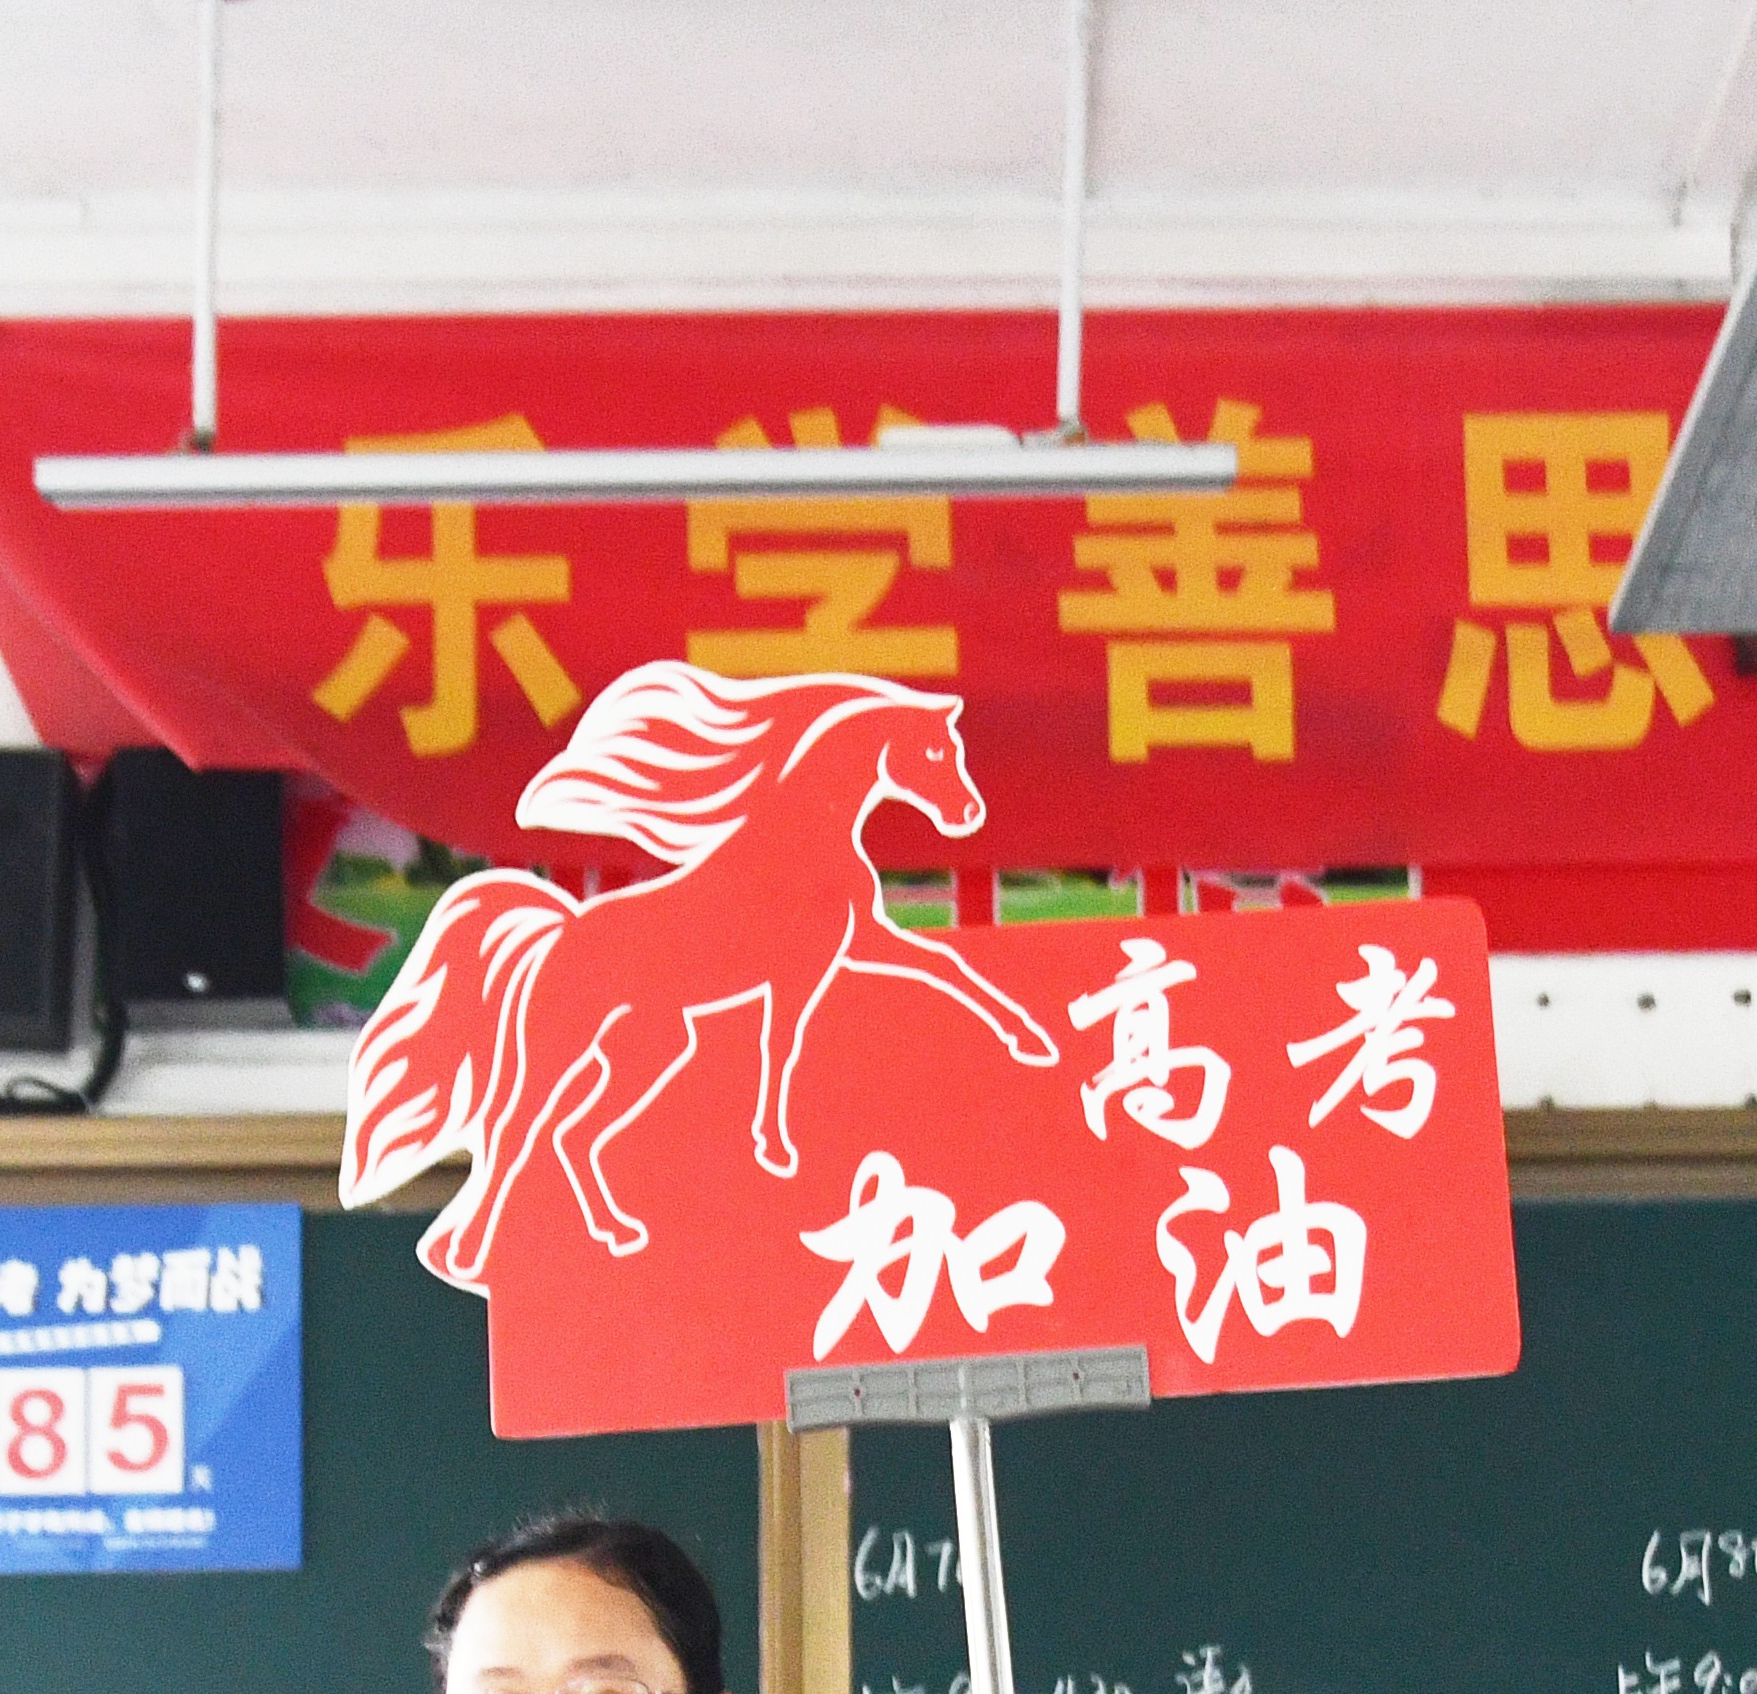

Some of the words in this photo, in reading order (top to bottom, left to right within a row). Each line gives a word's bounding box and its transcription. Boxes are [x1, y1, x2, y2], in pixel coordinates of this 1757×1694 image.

[311, 398, 1715, 766] 乐学善思
[1066, 936, 1456, 1150] 高考
[798, 1145, 1370, 1365] 加油
[853, 1525, 964, 1601] 6月7
